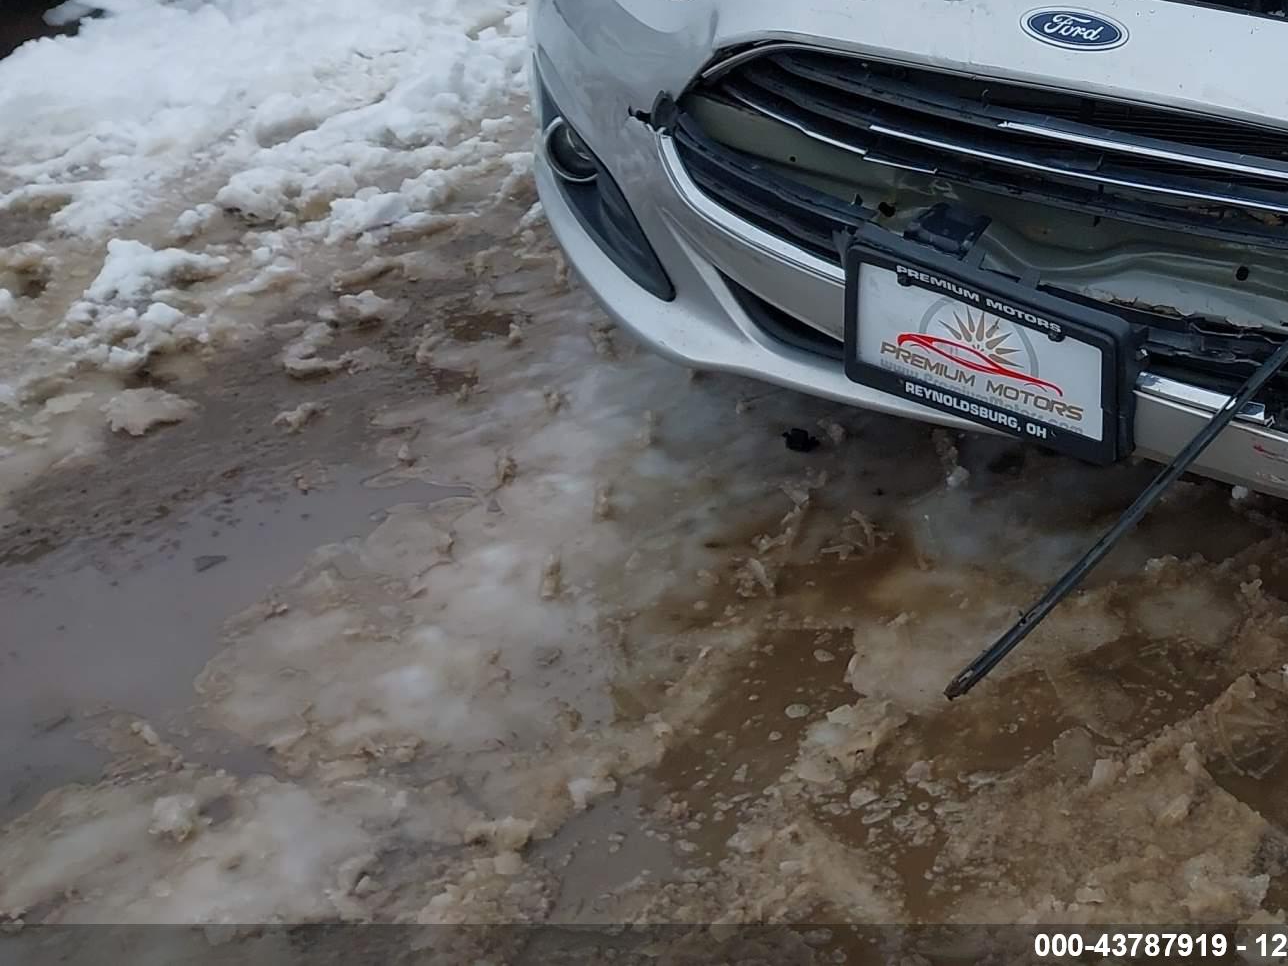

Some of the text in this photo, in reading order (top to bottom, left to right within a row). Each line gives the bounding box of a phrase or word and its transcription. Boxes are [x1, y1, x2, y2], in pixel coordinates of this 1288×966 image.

[1043, 14, 1105, 41] Ford
[896, 264, 1063, 334] PREMIUM MOTORS
[880, 341, 1084, 422] PREMIUM MOTORS
[880, 358, 1084, 435] www.PremiumMotorscom
[905, 381, 1048, 439] REYNOLDSBURG, OH
